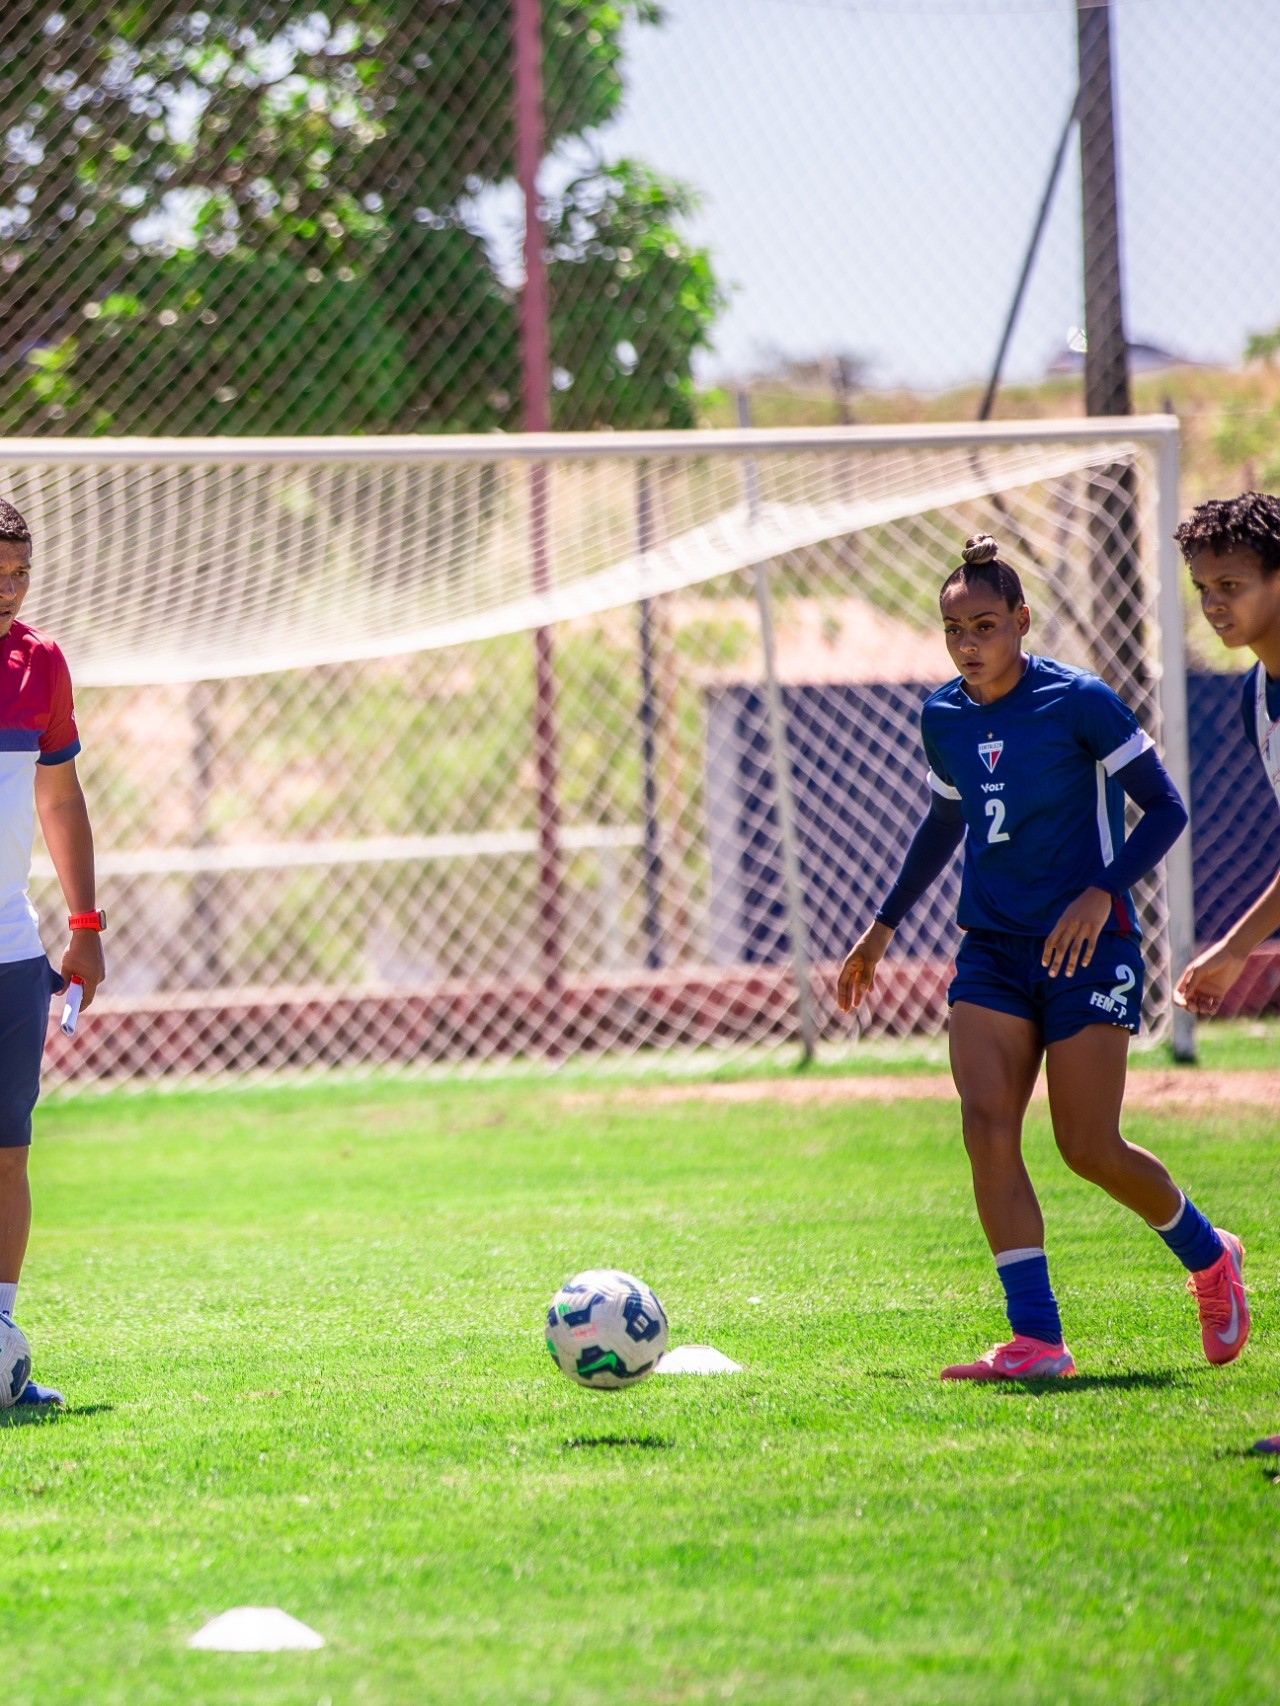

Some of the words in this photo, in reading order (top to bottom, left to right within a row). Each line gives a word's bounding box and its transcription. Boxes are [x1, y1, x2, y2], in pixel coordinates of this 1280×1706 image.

[980, 783, 1006, 793] VOLT
[985, 798, 1010, 844] 2
[1109, 964, 1136, 1006] 2
